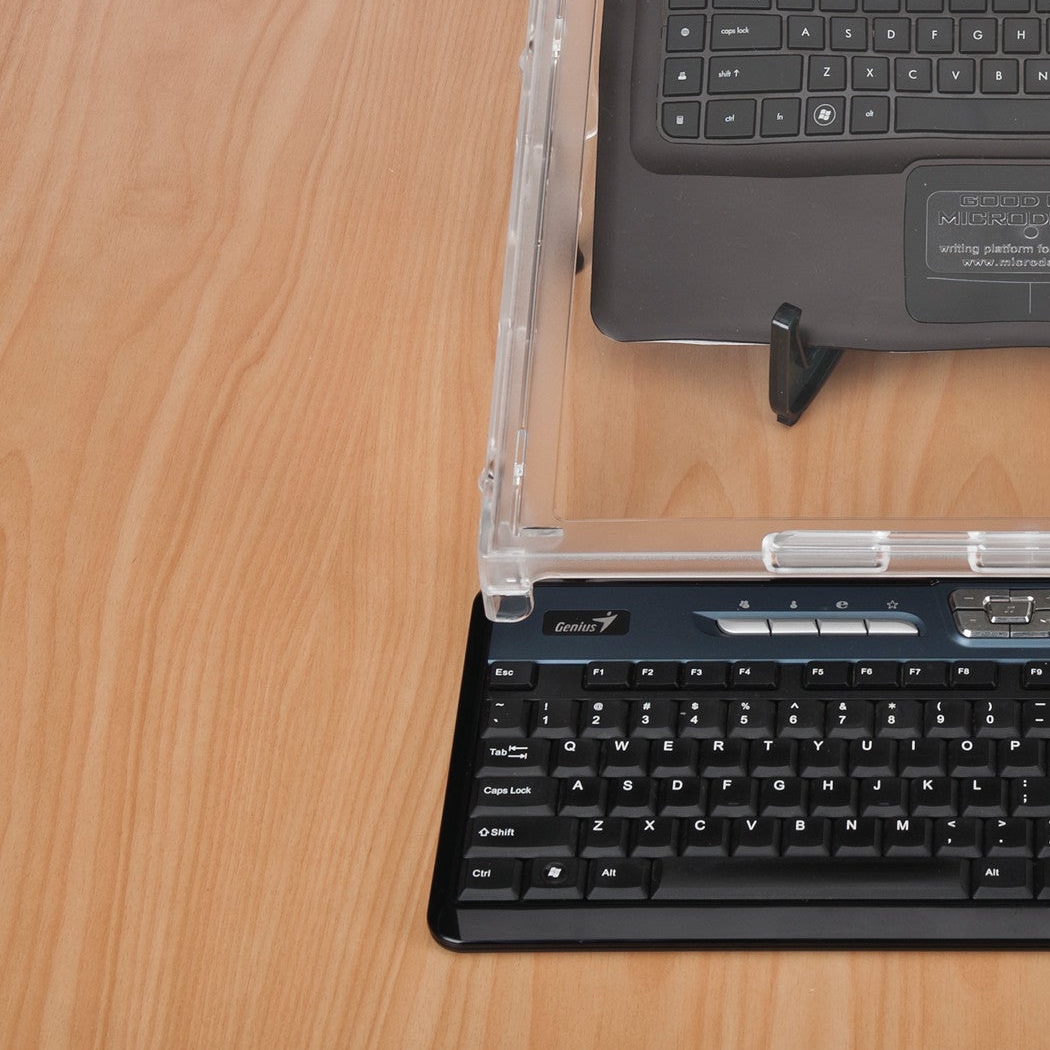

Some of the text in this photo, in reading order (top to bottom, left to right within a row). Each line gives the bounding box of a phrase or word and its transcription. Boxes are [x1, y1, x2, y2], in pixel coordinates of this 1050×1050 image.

[725, 114, 734, 122] ctrl
[960, 195, 1040, 208] GOOD
[939, 244, 979, 255] writing
[984, 244, 1033, 255] platform
[555, 620, 598, 632] Genius
[565, 741, 576, 751] Q
[615, 741, 629, 751] W
[664, 741, 673, 751] E
[714, 741, 723, 750] R
[764, 741, 773, 750] T
[814, 741, 823, 750] Y
[862, 741, 872, 750] U
[912, 741, 915, 750] I
[962, 741, 972, 750] O
[1011, 741, 1020, 750] P
[484, 787, 508, 795] Caps
[473, 869, 491, 877] Ctrl
